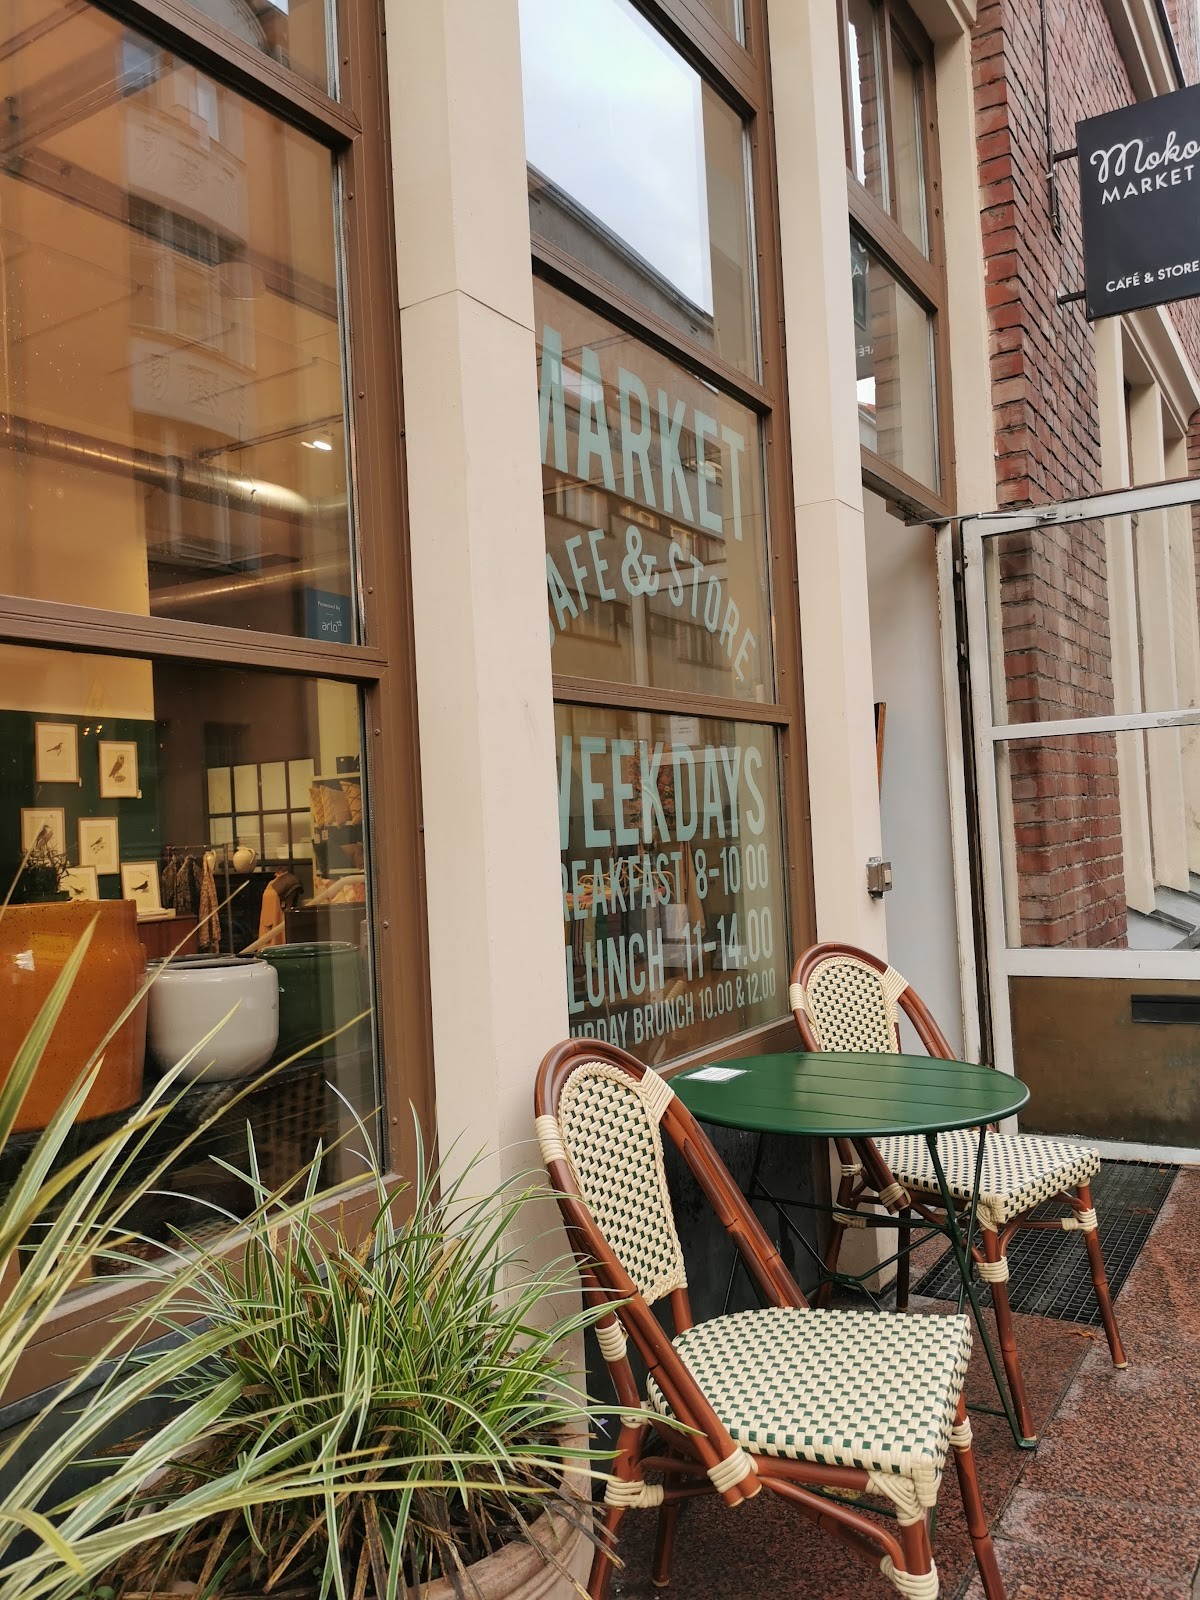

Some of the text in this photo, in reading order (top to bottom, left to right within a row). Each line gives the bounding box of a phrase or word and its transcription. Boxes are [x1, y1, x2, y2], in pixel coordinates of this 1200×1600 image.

[1089, 130, 1200, 184] Moko
[1101, 164, 1195, 205] MARKET
[1105, 259, 1200, 293] CAFÉ & STORE
[545, 525, 756, 683] AFE & STORE
[567, 906, 774, 1015] LUNCH 11-14.00
[633, 991, 695, 1046] BRUNCH
[698, 980, 733, 1022] 10.00
